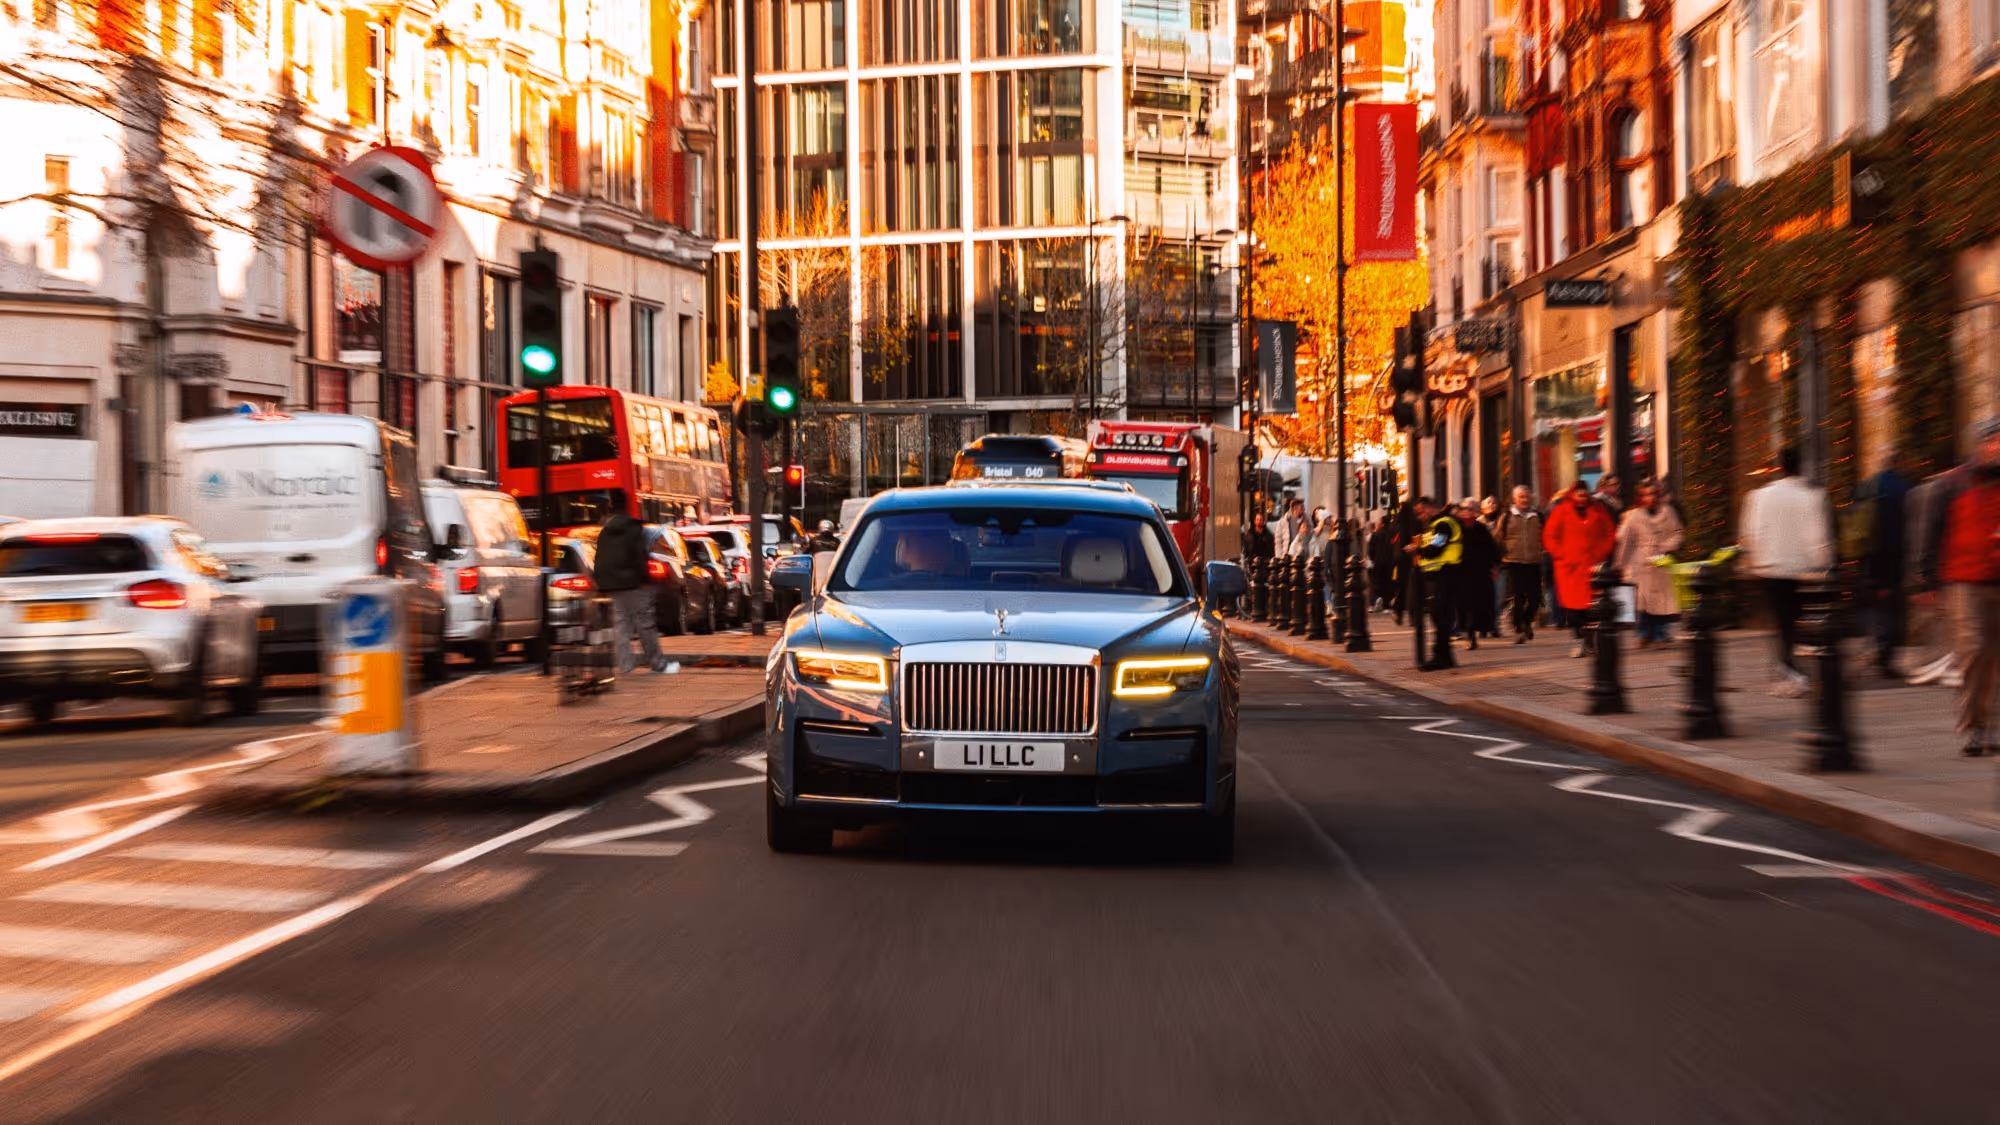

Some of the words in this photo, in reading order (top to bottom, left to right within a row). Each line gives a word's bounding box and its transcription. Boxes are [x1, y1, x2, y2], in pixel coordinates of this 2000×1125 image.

[549, 444, 574, 461] 74
[1106, 455, 1168, 466] OLDENBURGER
[984, 466, 1013, 477] Bristol
[1025, 466, 1044, 477] 040
